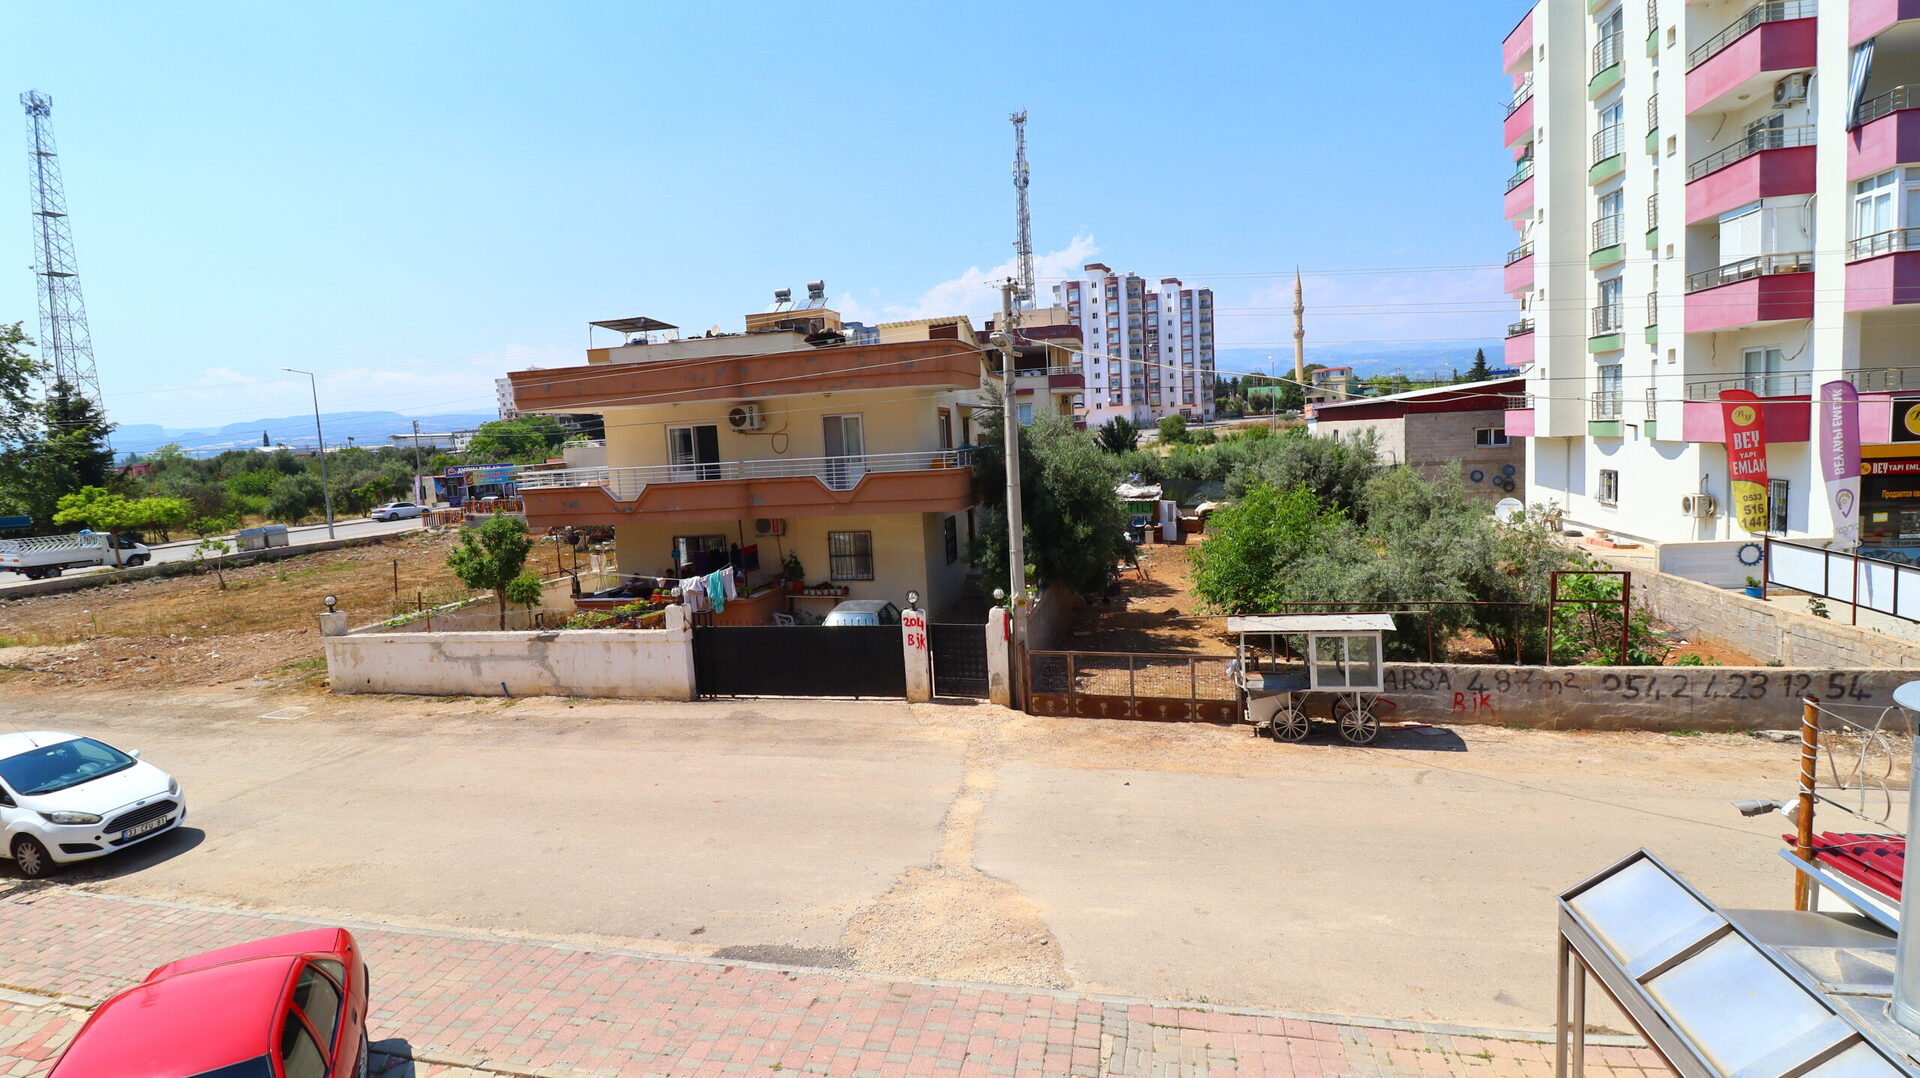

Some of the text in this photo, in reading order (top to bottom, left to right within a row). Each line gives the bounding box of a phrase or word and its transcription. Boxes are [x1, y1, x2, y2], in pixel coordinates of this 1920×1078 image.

[1733, 430, 1760, 450] BEY
[1739, 451, 1757, 459] YAPI
[1732, 458, 1767, 475] EMLAK
[1872, 462, 1888, 474] BEY
[1888, 463, 1904, 471] YAPI
[1905, 463, 1920, 471] EML
[1742, 493, 1763, 502] 0533
[1743, 503, 1765, 515] 516
[1741, 515, 1767, 529] 1447
[903, 617, 924, 631] 204
[1383, 668, 1452, 691] ARSA
[1825, 671, 1872, 700] 54
